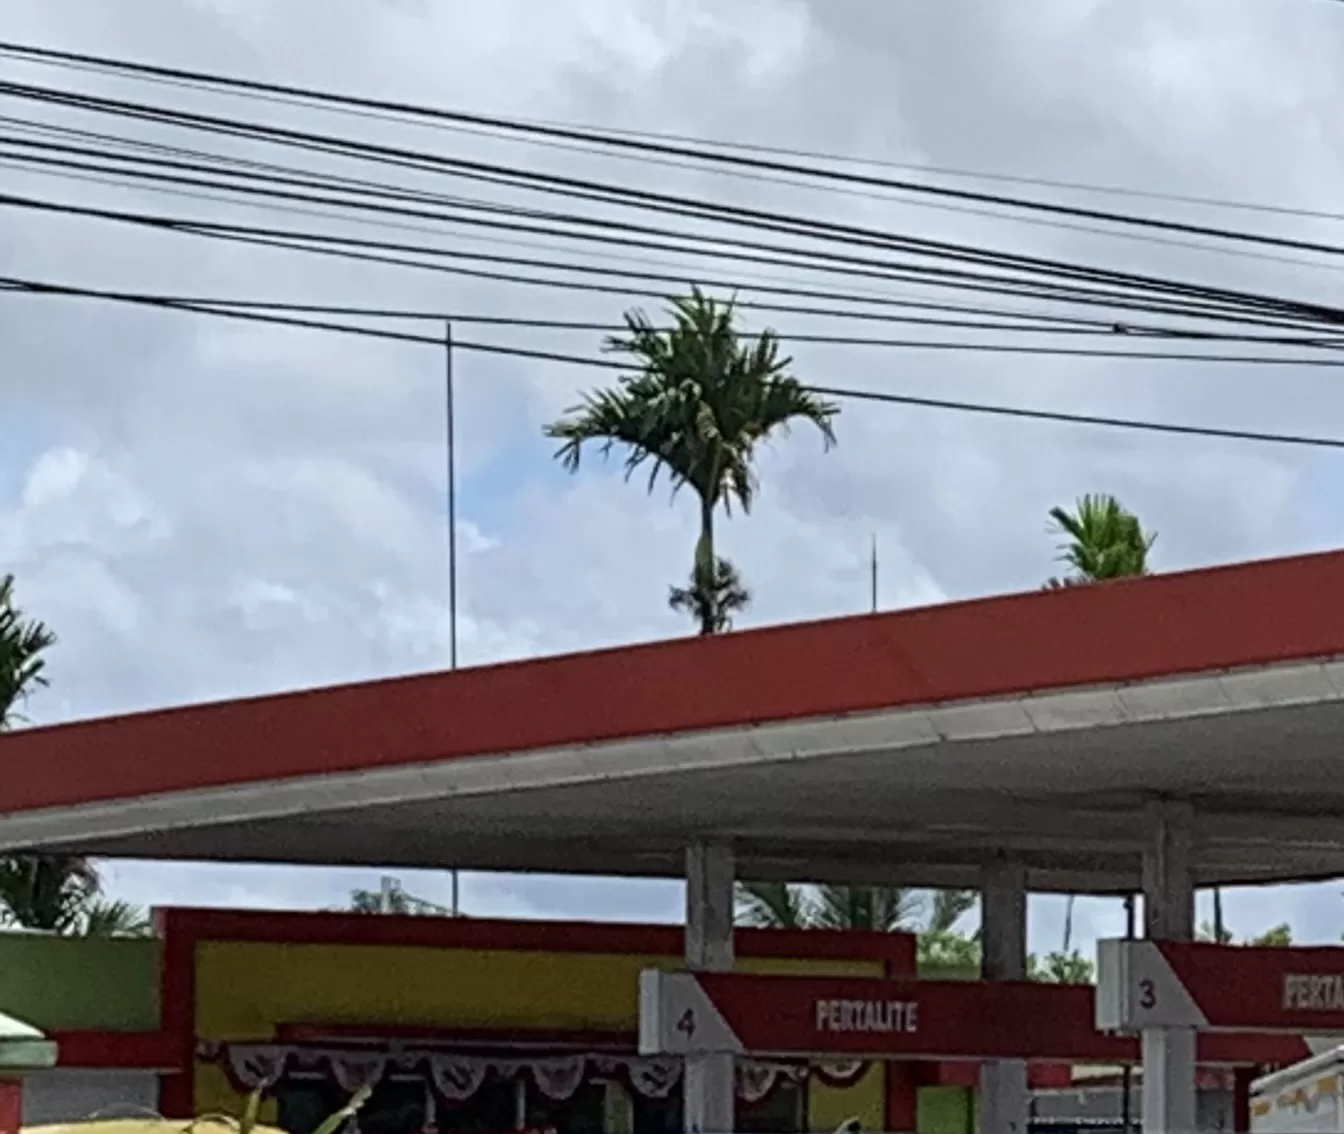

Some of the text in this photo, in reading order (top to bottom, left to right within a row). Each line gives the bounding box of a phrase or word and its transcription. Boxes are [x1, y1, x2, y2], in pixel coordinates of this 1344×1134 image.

[1139, 978, 1157, 1009] 3
[676, 1009, 695, 1041] 4
[815, 999, 918, 1032] PERTALITE
